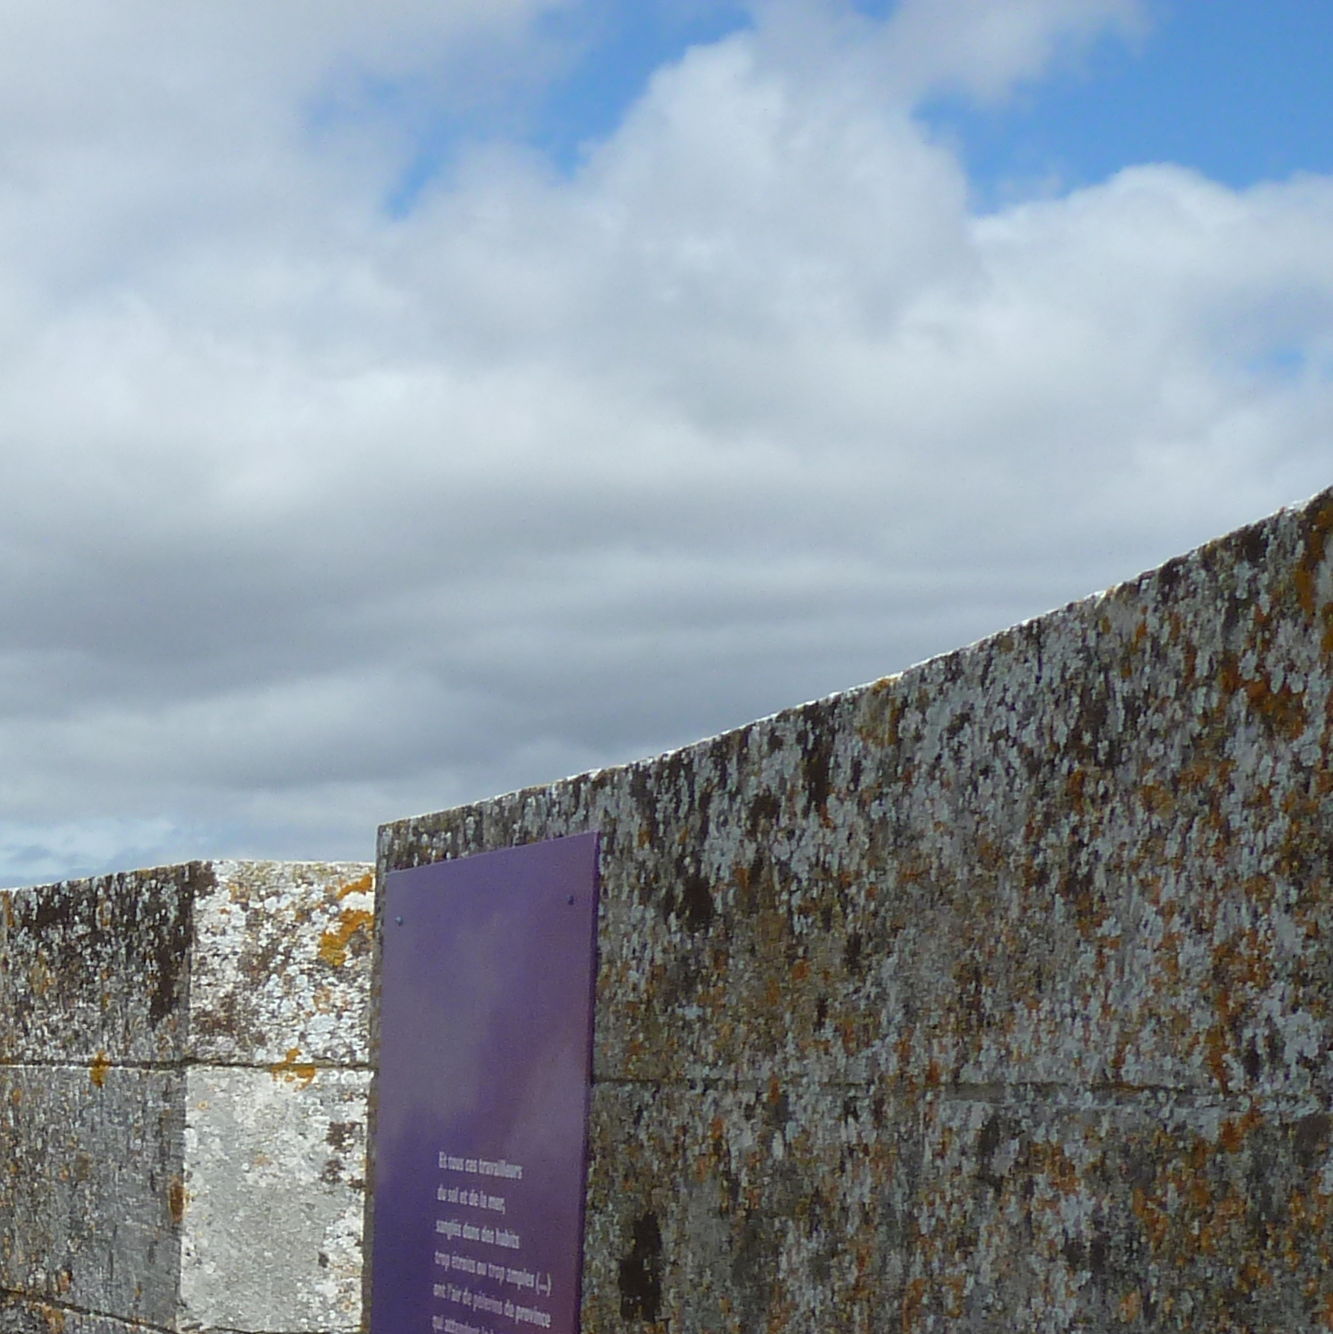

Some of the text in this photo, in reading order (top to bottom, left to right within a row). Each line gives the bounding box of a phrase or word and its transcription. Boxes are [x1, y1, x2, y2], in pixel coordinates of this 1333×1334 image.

[479, 1158, 523, 1180] travailleurs
[460, 1190, 467, 1205] et
[469, 1189, 479, 1206] de
[480, 1190, 487, 1208] la
[434, 1250, 450, 1271] trop
[488, 1262, 505, 1286] trop
[433, 1283, 446, 1298] ont
[463, 1287, 472, 1306] de
[504, 1299, 515, 1318] de
[515, 1304, 552, 1329] province
[432, 1315, 444, 1333] qui
